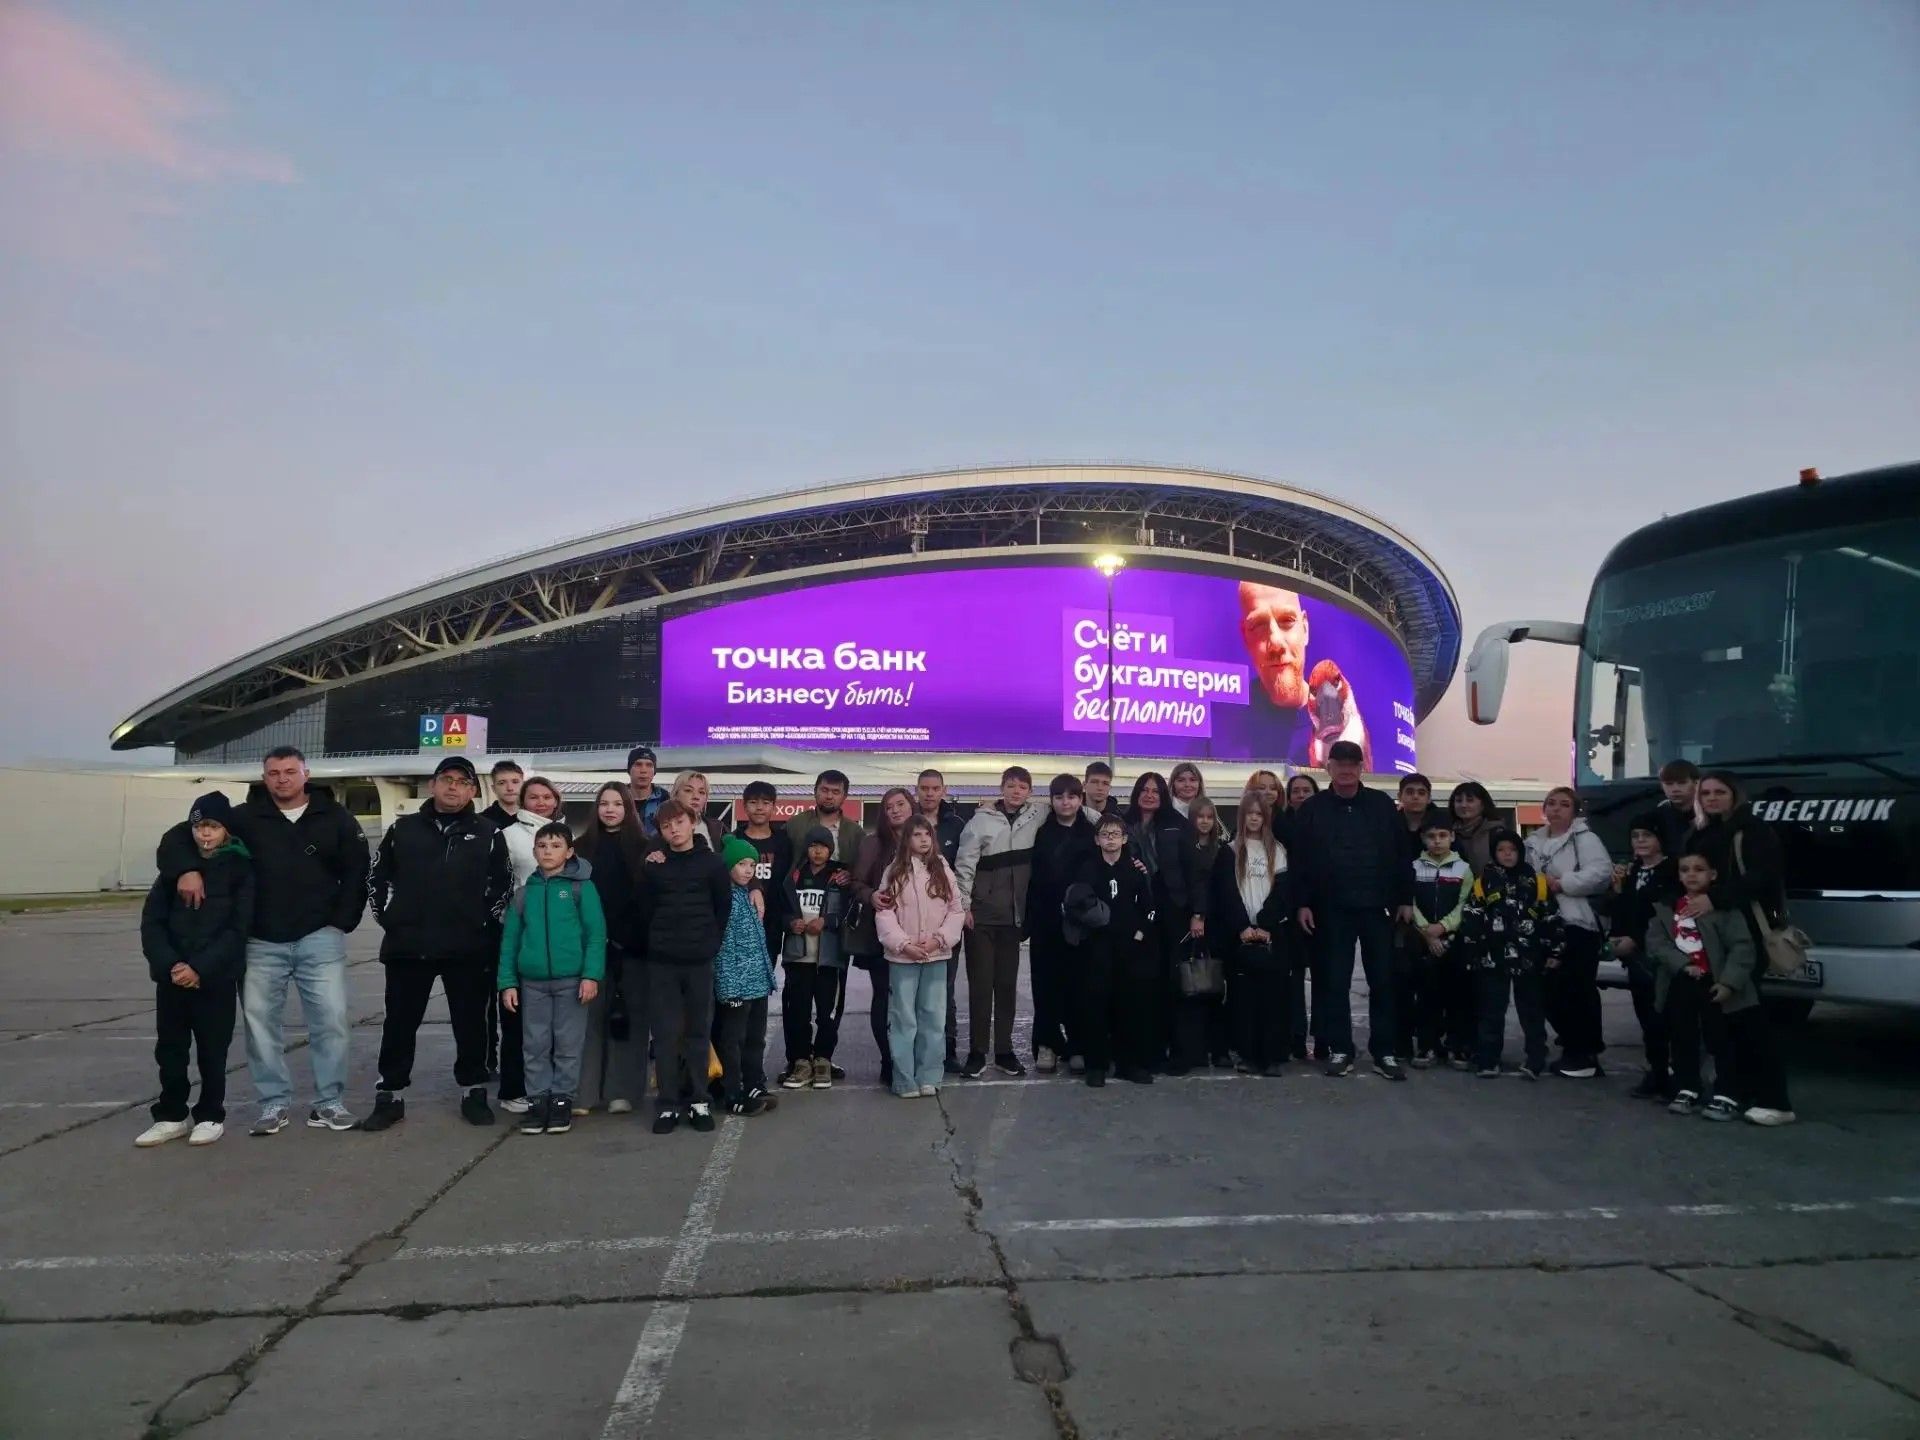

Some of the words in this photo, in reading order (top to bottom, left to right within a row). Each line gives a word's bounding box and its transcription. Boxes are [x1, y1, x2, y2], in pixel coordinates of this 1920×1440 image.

[1074, 619, 1145, 653] Счёт
[1150, 632, 1167, 654] и
[712, 648, 826, 670] точка
[834, 642, 927, 672] банк
[1074, 654, 1241, 698] бухгалтерия
[727, 682, 840, 710] Бизнесу
[844, 681, 914, 707] быть!
[1074, 688, 1206, 728] бесплатно
[425, 719, 438, 732] D
[448, 718, 461, 732] A
[422, 737, 429, 745] C
[446, 736, 453, 744] B
[776, 805, 804, 816] ХОД
[1752, 798, 1897, 821] ЕВЕСТНИК
